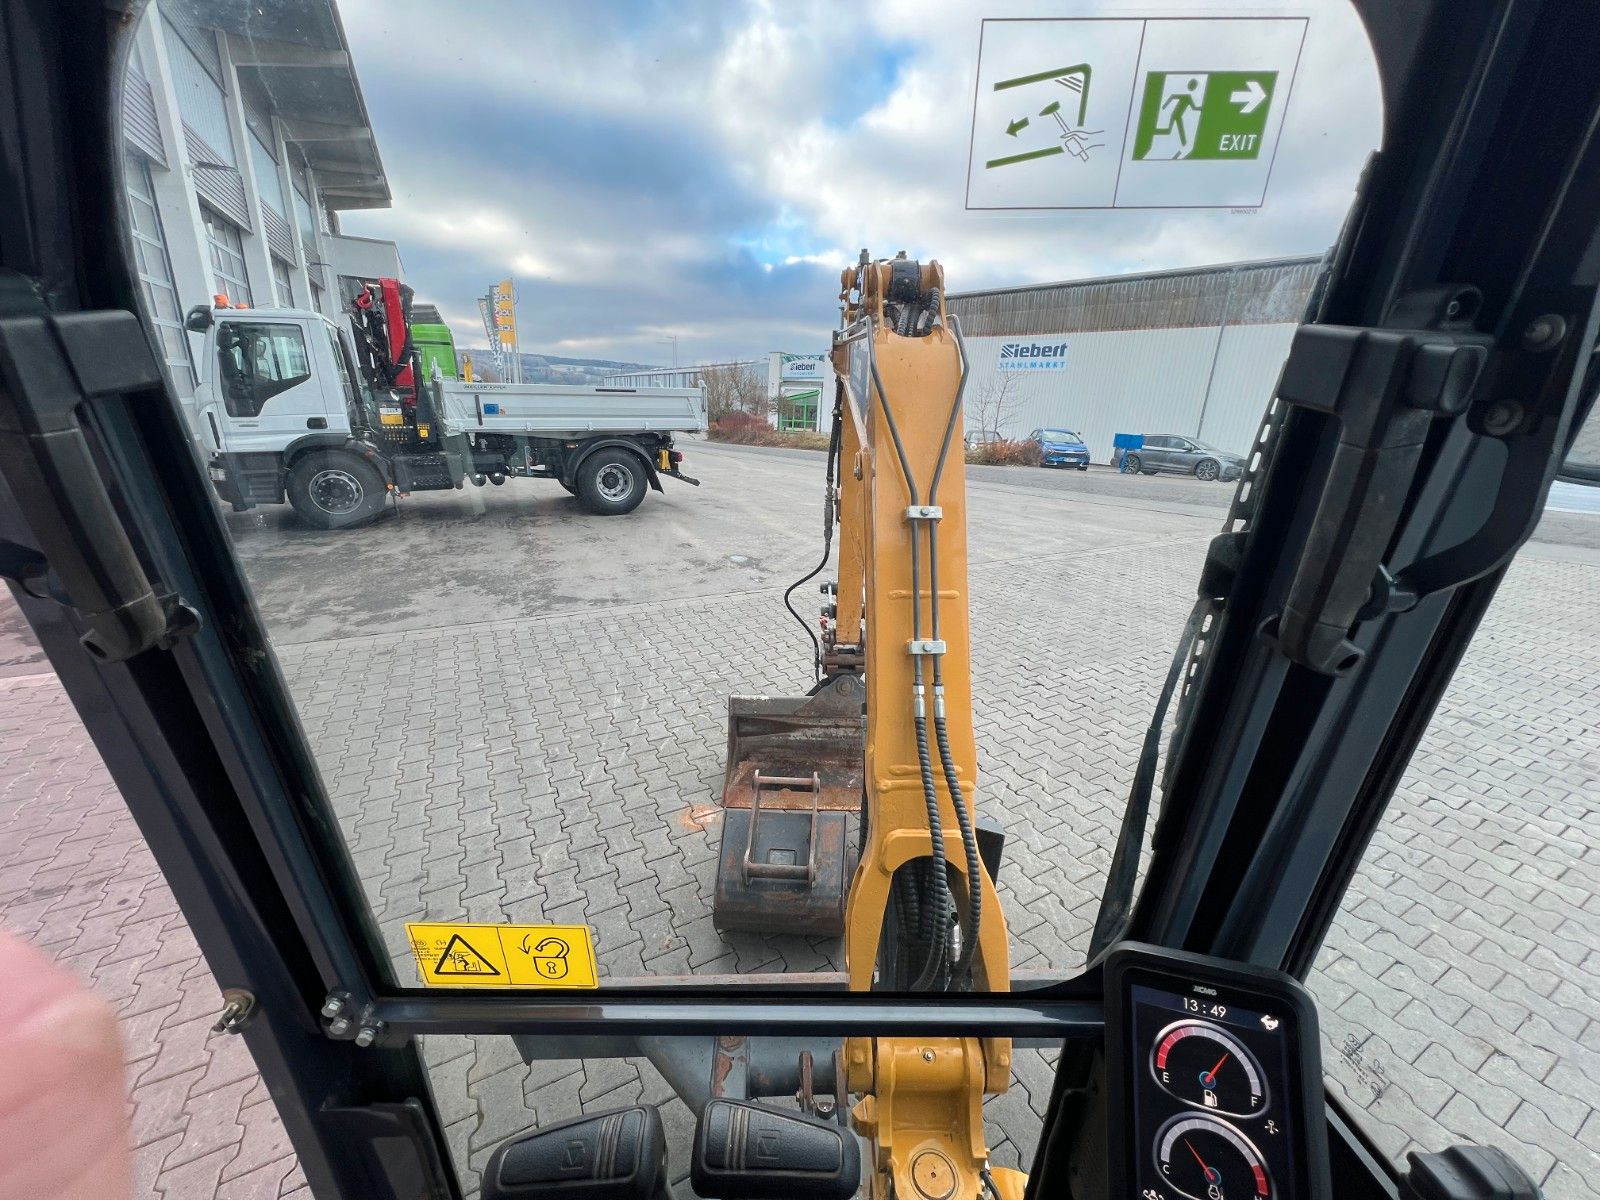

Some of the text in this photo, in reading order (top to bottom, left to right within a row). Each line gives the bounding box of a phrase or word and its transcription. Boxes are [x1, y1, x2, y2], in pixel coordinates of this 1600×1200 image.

[1219, 134, 1257, 151] EXIT
[1001, 342, 1067, 358] Siebert
[790, 362, 816, 371] Siebert
[1162, 1071, 1170, 1084] E
[1251, 1096, 1258, 1108] F
[1162, 1164, 1170, 1175] C
